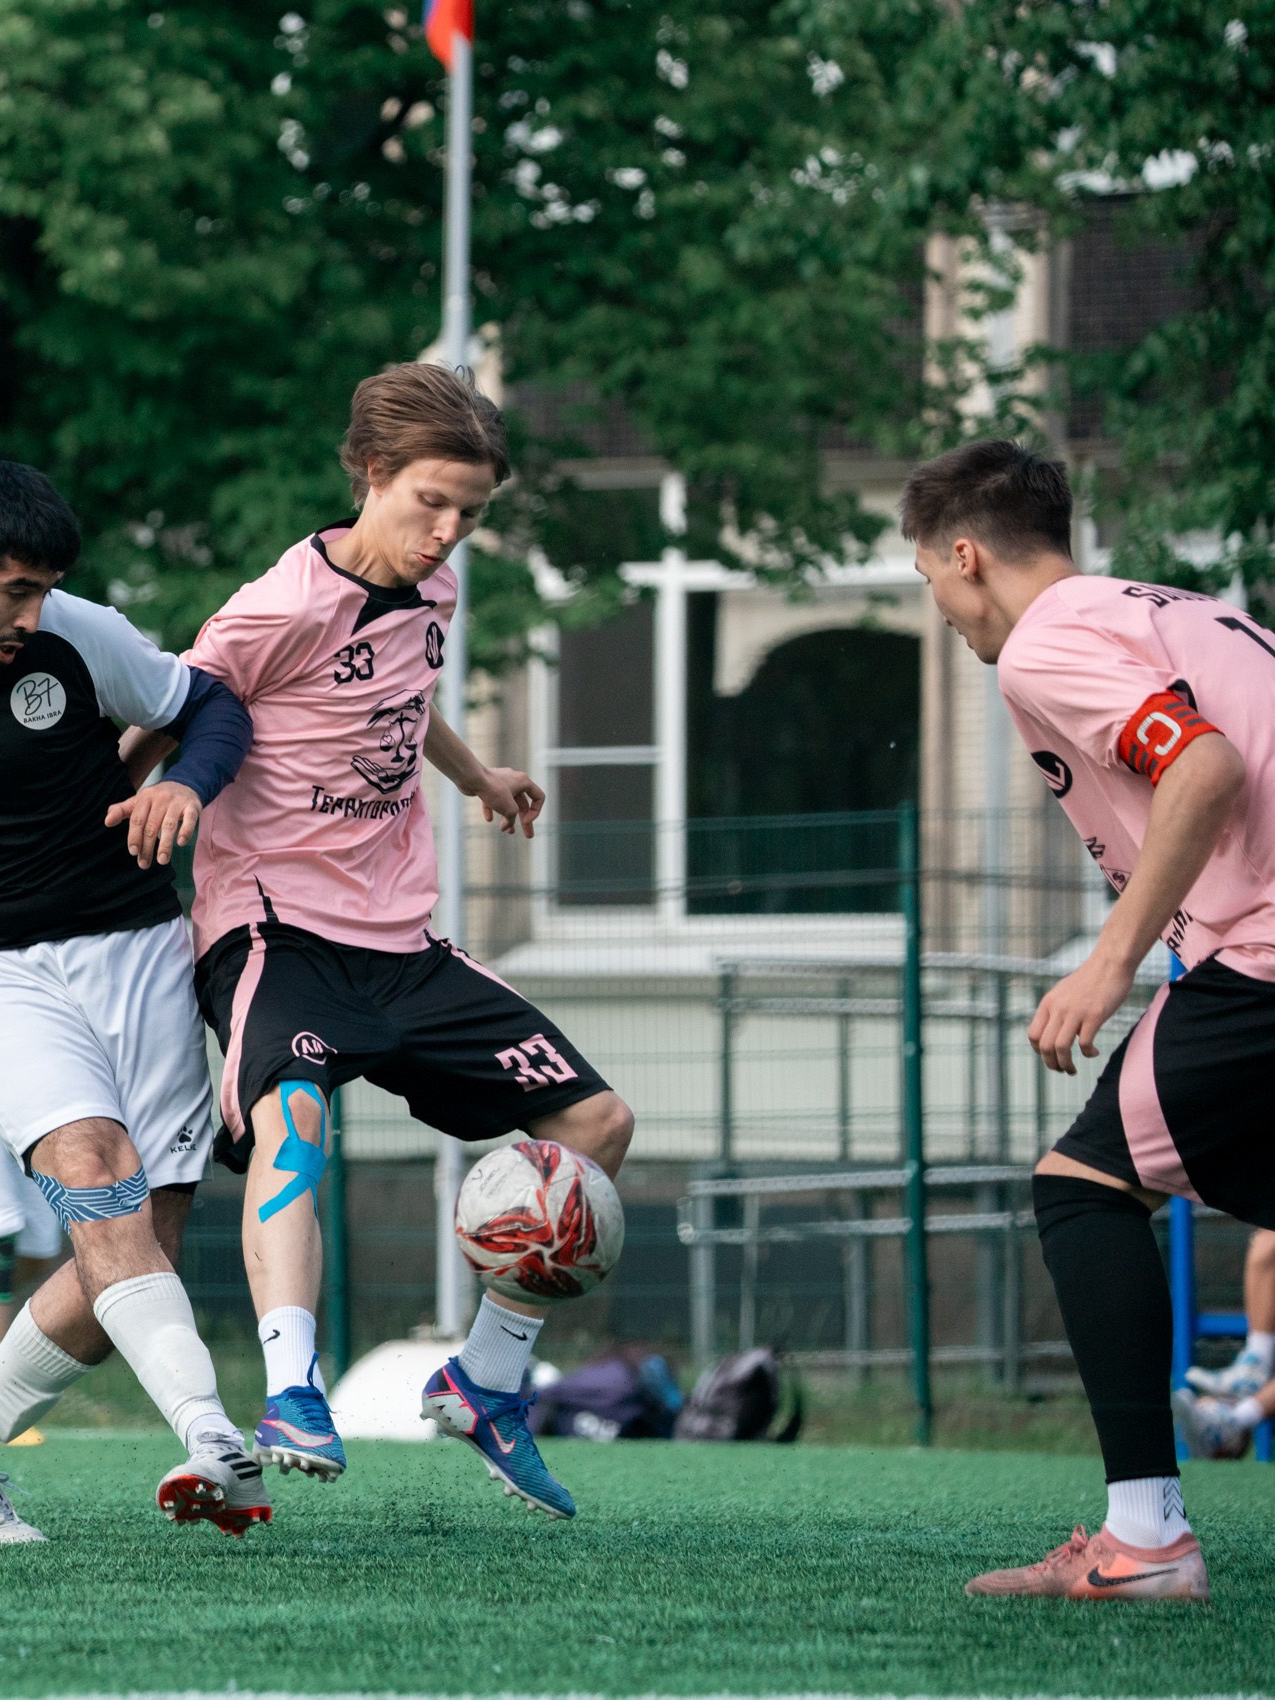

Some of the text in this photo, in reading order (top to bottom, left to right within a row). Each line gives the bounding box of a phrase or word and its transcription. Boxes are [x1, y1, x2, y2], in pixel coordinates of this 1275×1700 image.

[333, 641, 375, 685] 33
[23, 710, 62, 724] BAKHA IBRA
[1136, 711, 1182, 756] C
[494, 1033, 578, 1093] 33
